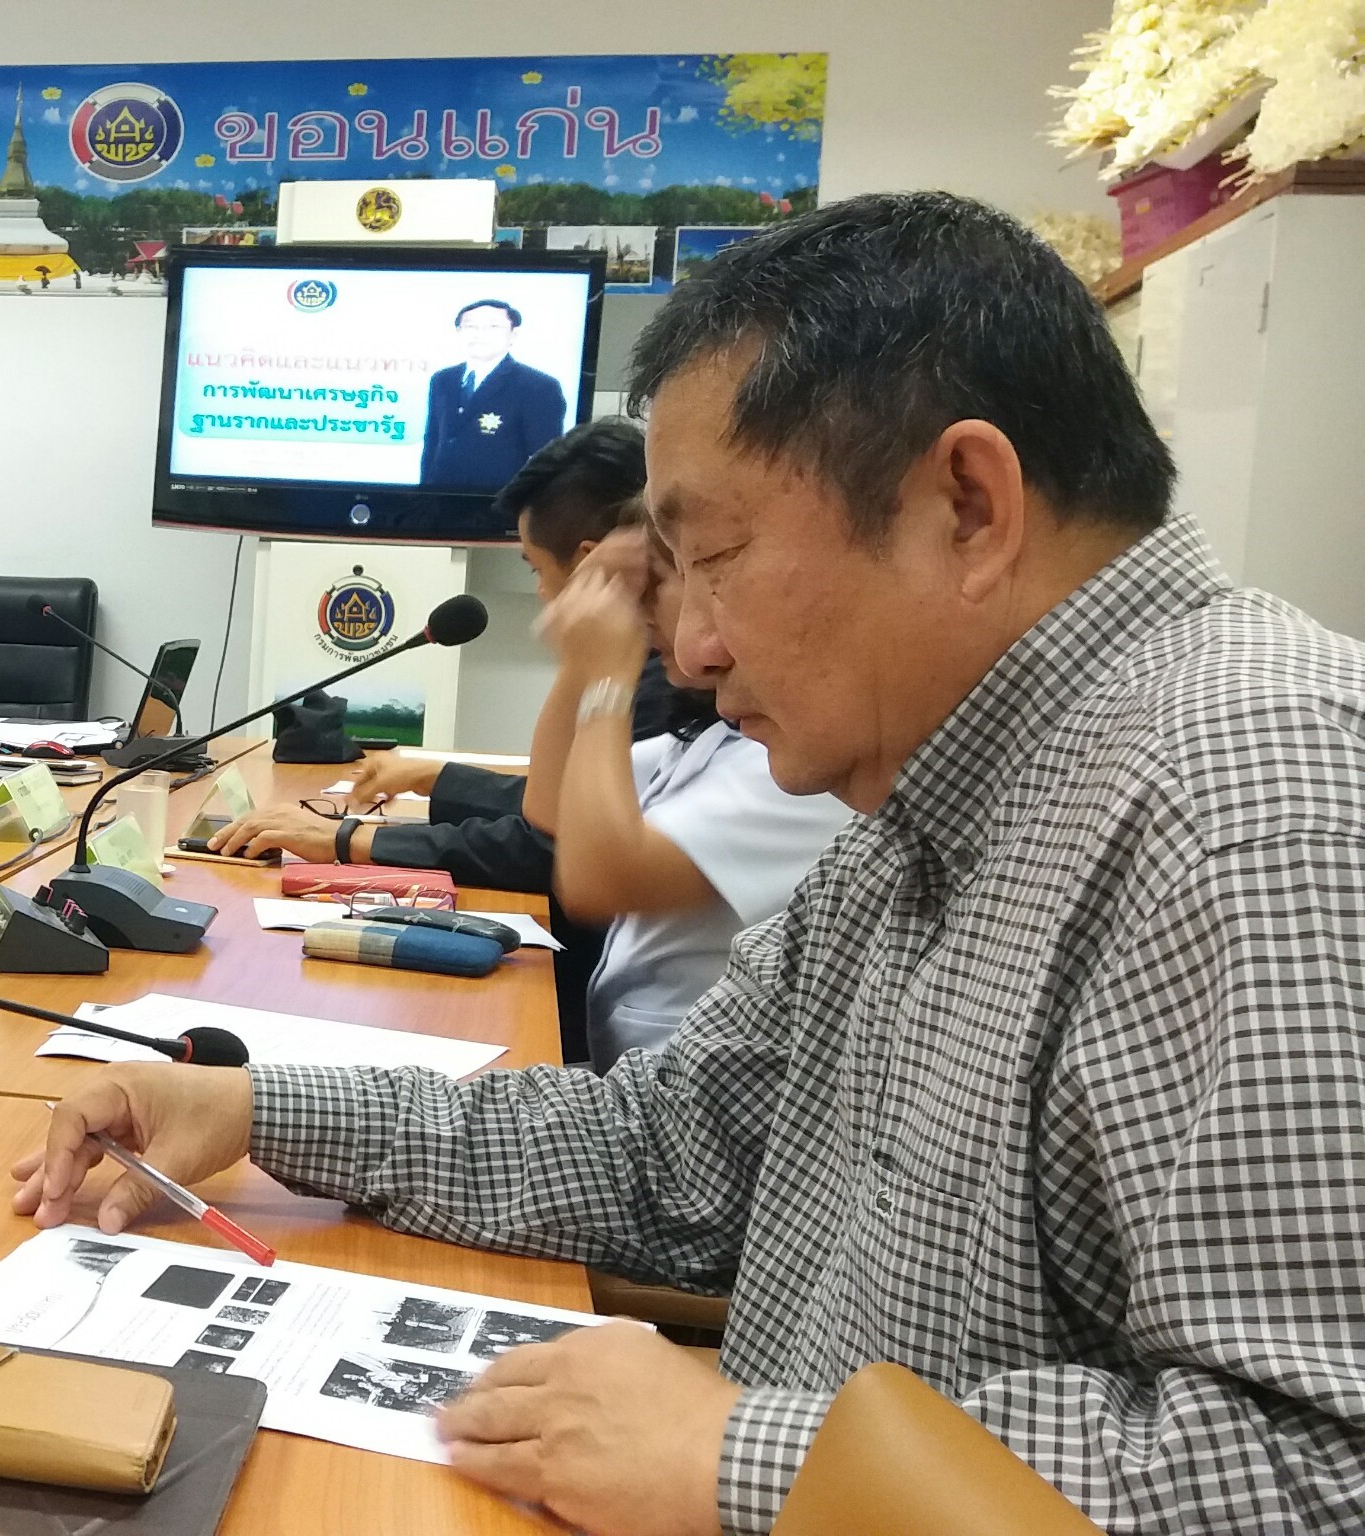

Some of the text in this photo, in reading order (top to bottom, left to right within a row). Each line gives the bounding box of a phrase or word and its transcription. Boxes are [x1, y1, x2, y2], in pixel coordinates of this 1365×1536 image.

[214, 86, 662, 162] ขอนแก่น
[187, 348, 430, 373] แนวคิดและแนวทาง
[202, 380, 399, 409] การพัฒนาเศรษฐกิจ
[189, 414, 406, 440] ฐานรากและประชารัฐ
[314, 633, 399, 663] กรมการพัฒนาชมชน
